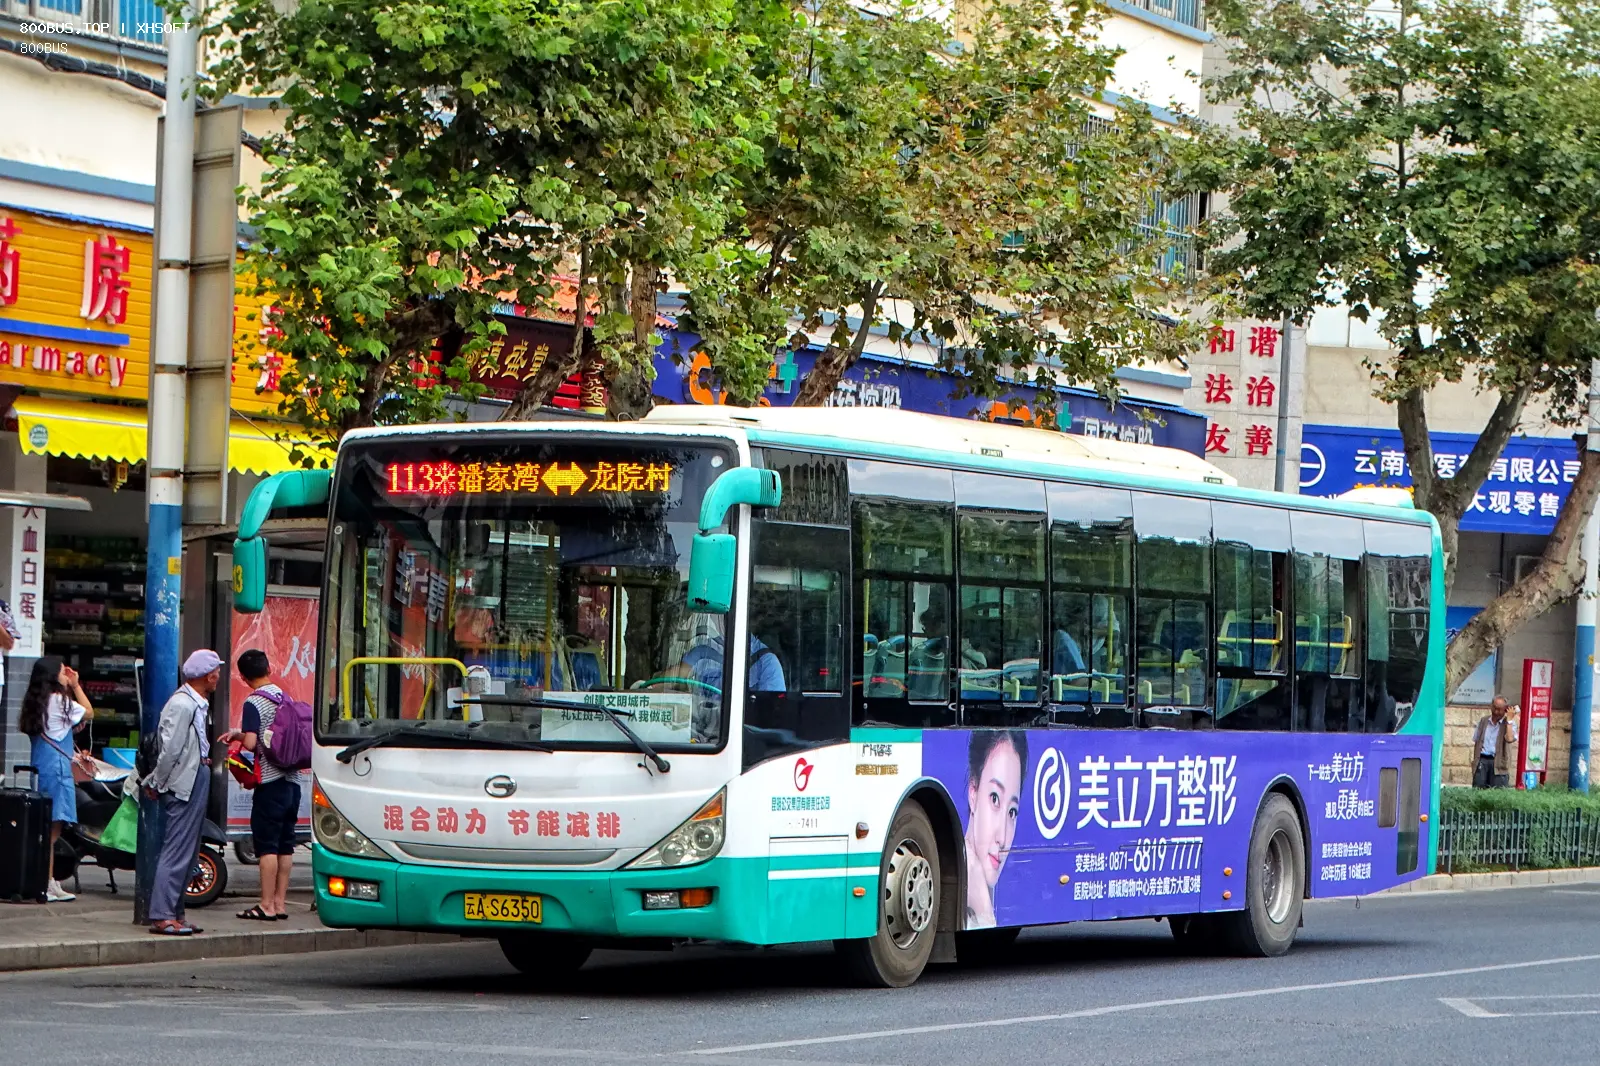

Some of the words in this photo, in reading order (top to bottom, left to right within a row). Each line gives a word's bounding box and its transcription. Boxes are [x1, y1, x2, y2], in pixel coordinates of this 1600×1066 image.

[1207, 325, 1278, 358] 和谐
[1204, 373, 1276, 407] 法治
[1205, 423, 1273, 456] 友善
[387, 463, 433, 493] 113
[457, 462, 541, 493] 潘家湾
[588, 461, 673, 493] 龙院村
[1354, 449, 1582, 485] 云南医有限公司
[584, 694, 650, 708] 创建文明城市
[628, 709, 673, 723] 从我做起
[1307, 751, 1364, 783] 下一站去美立方
[1077, 755, 1238, 829] 美立方整形
[1325, 789, 1374, 821] 遇见更美的自己
[383, 804, 487, 835] 混合动力
[507, 809, 621, 838] 节能减排
